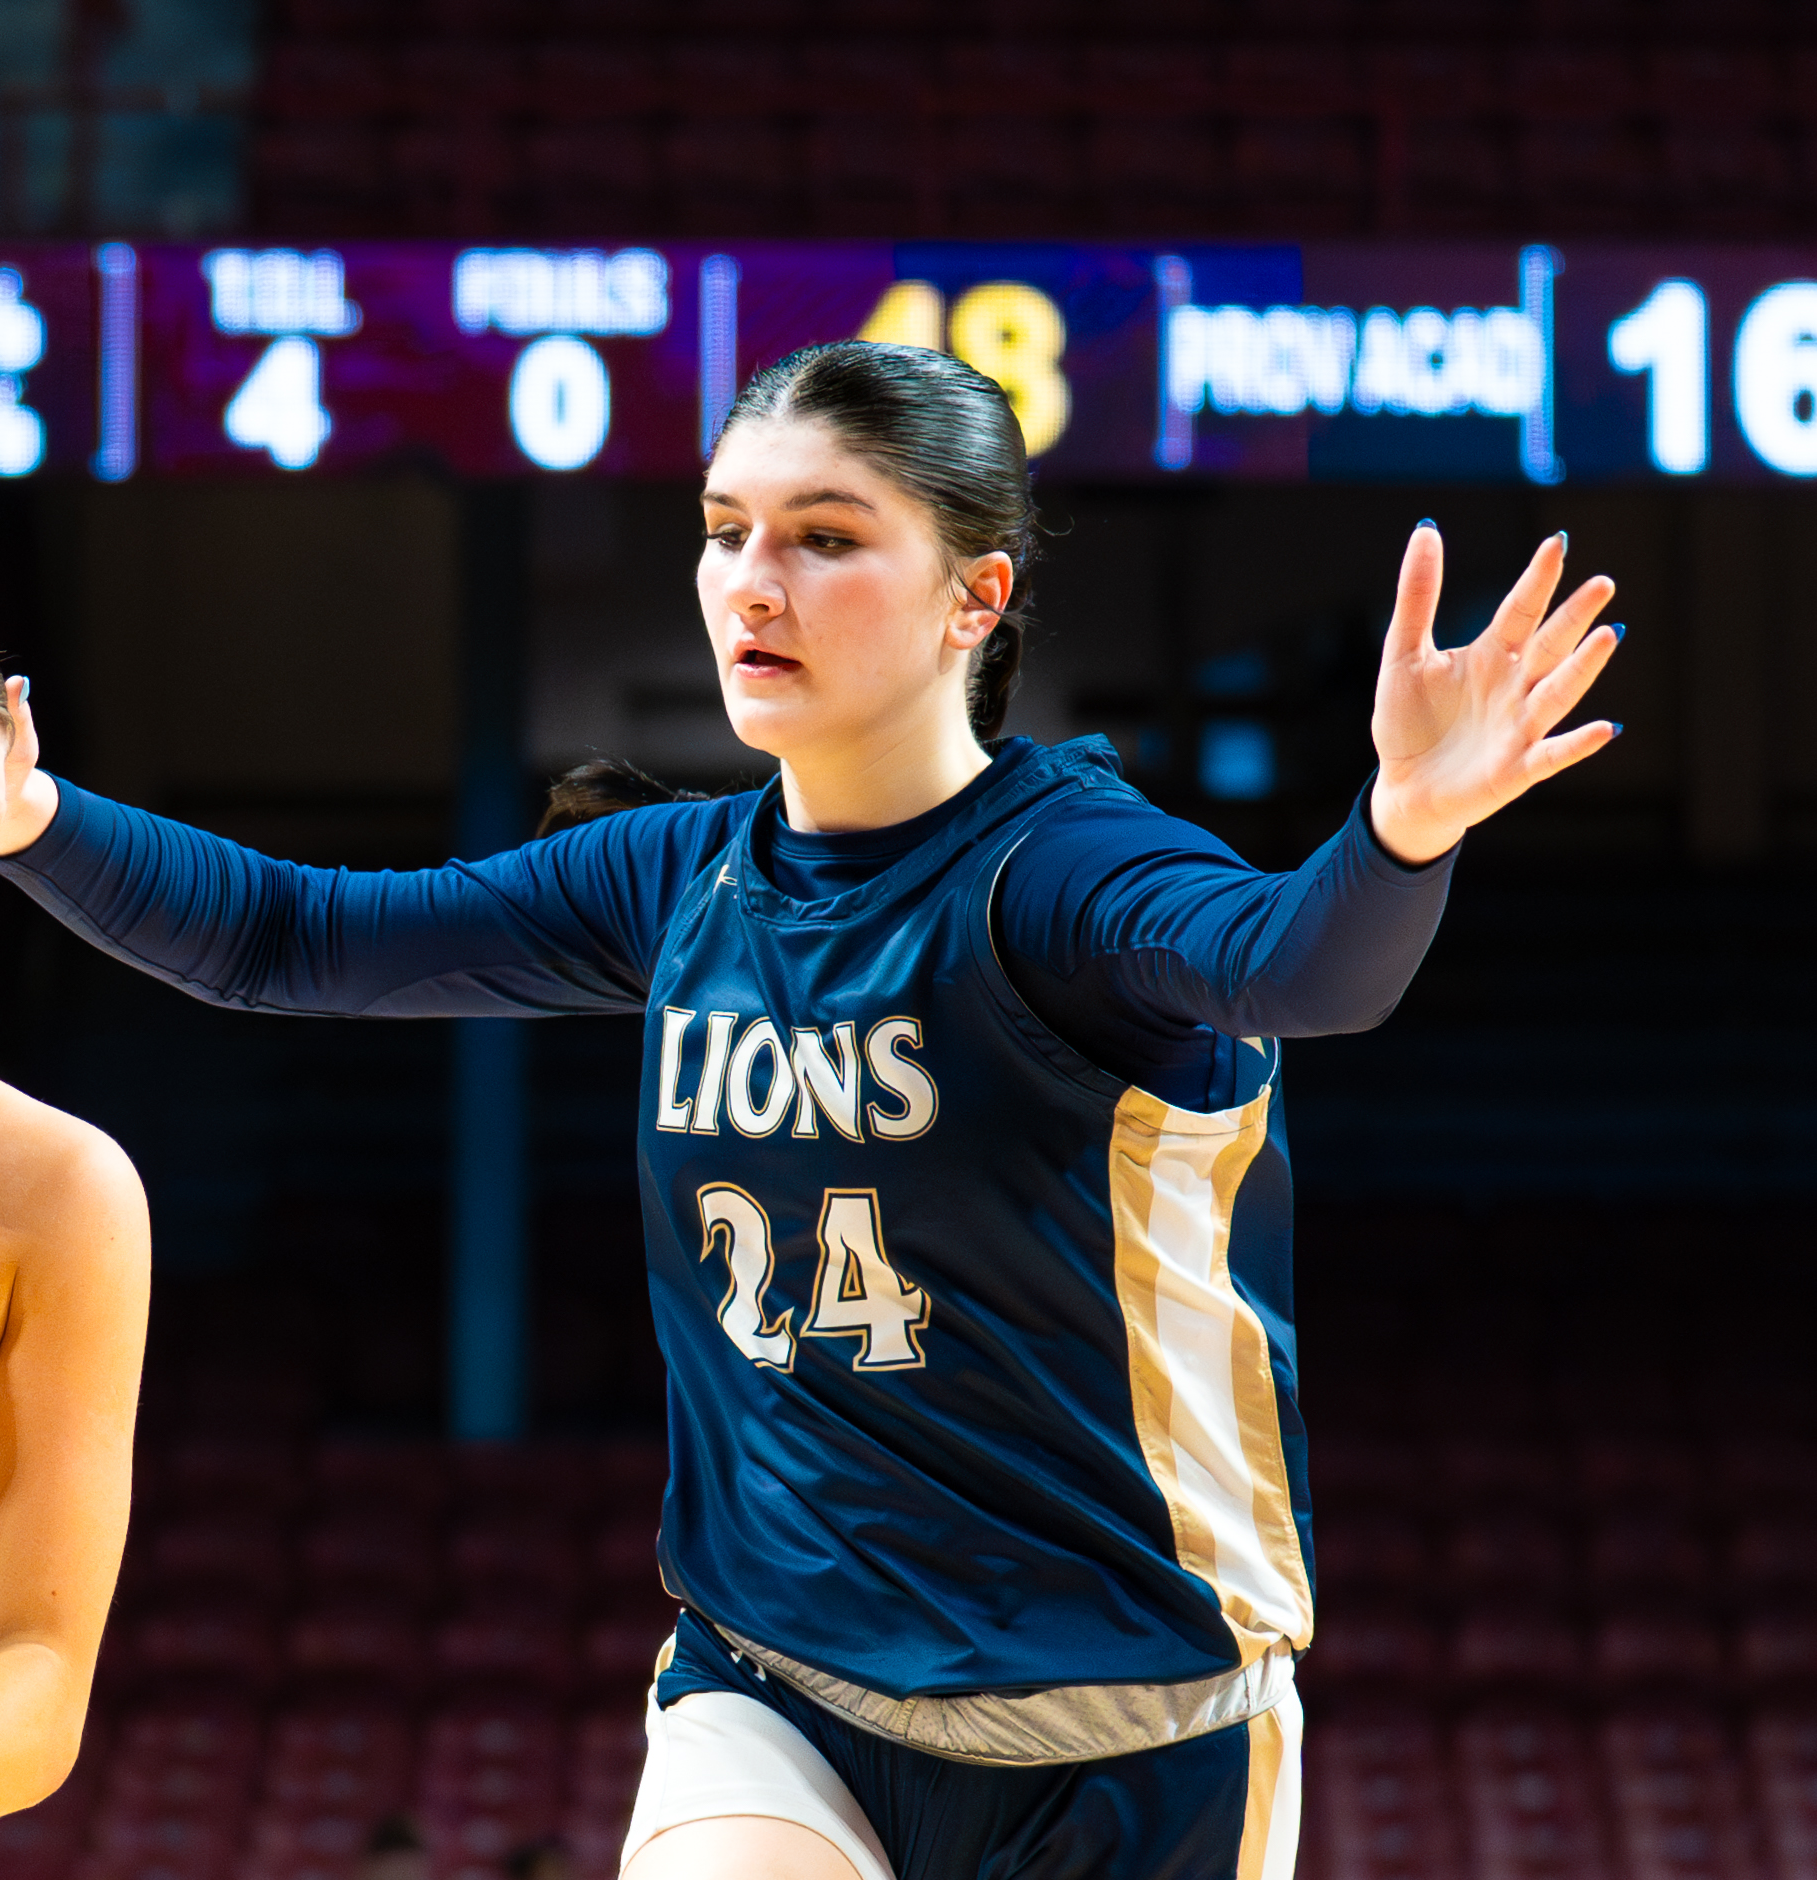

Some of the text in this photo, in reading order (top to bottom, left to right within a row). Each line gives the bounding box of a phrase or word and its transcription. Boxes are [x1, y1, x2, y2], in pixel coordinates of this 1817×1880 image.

[452, 247, 670, 337] FOULS
[1170, 304, 1356, 414] PROV
[223, 335, 331, 470] 4
[510, 334, 610, 470] 0
[656, 1006, 939, 1143] LIONS
[696, 1181, 932, 1373] 24
